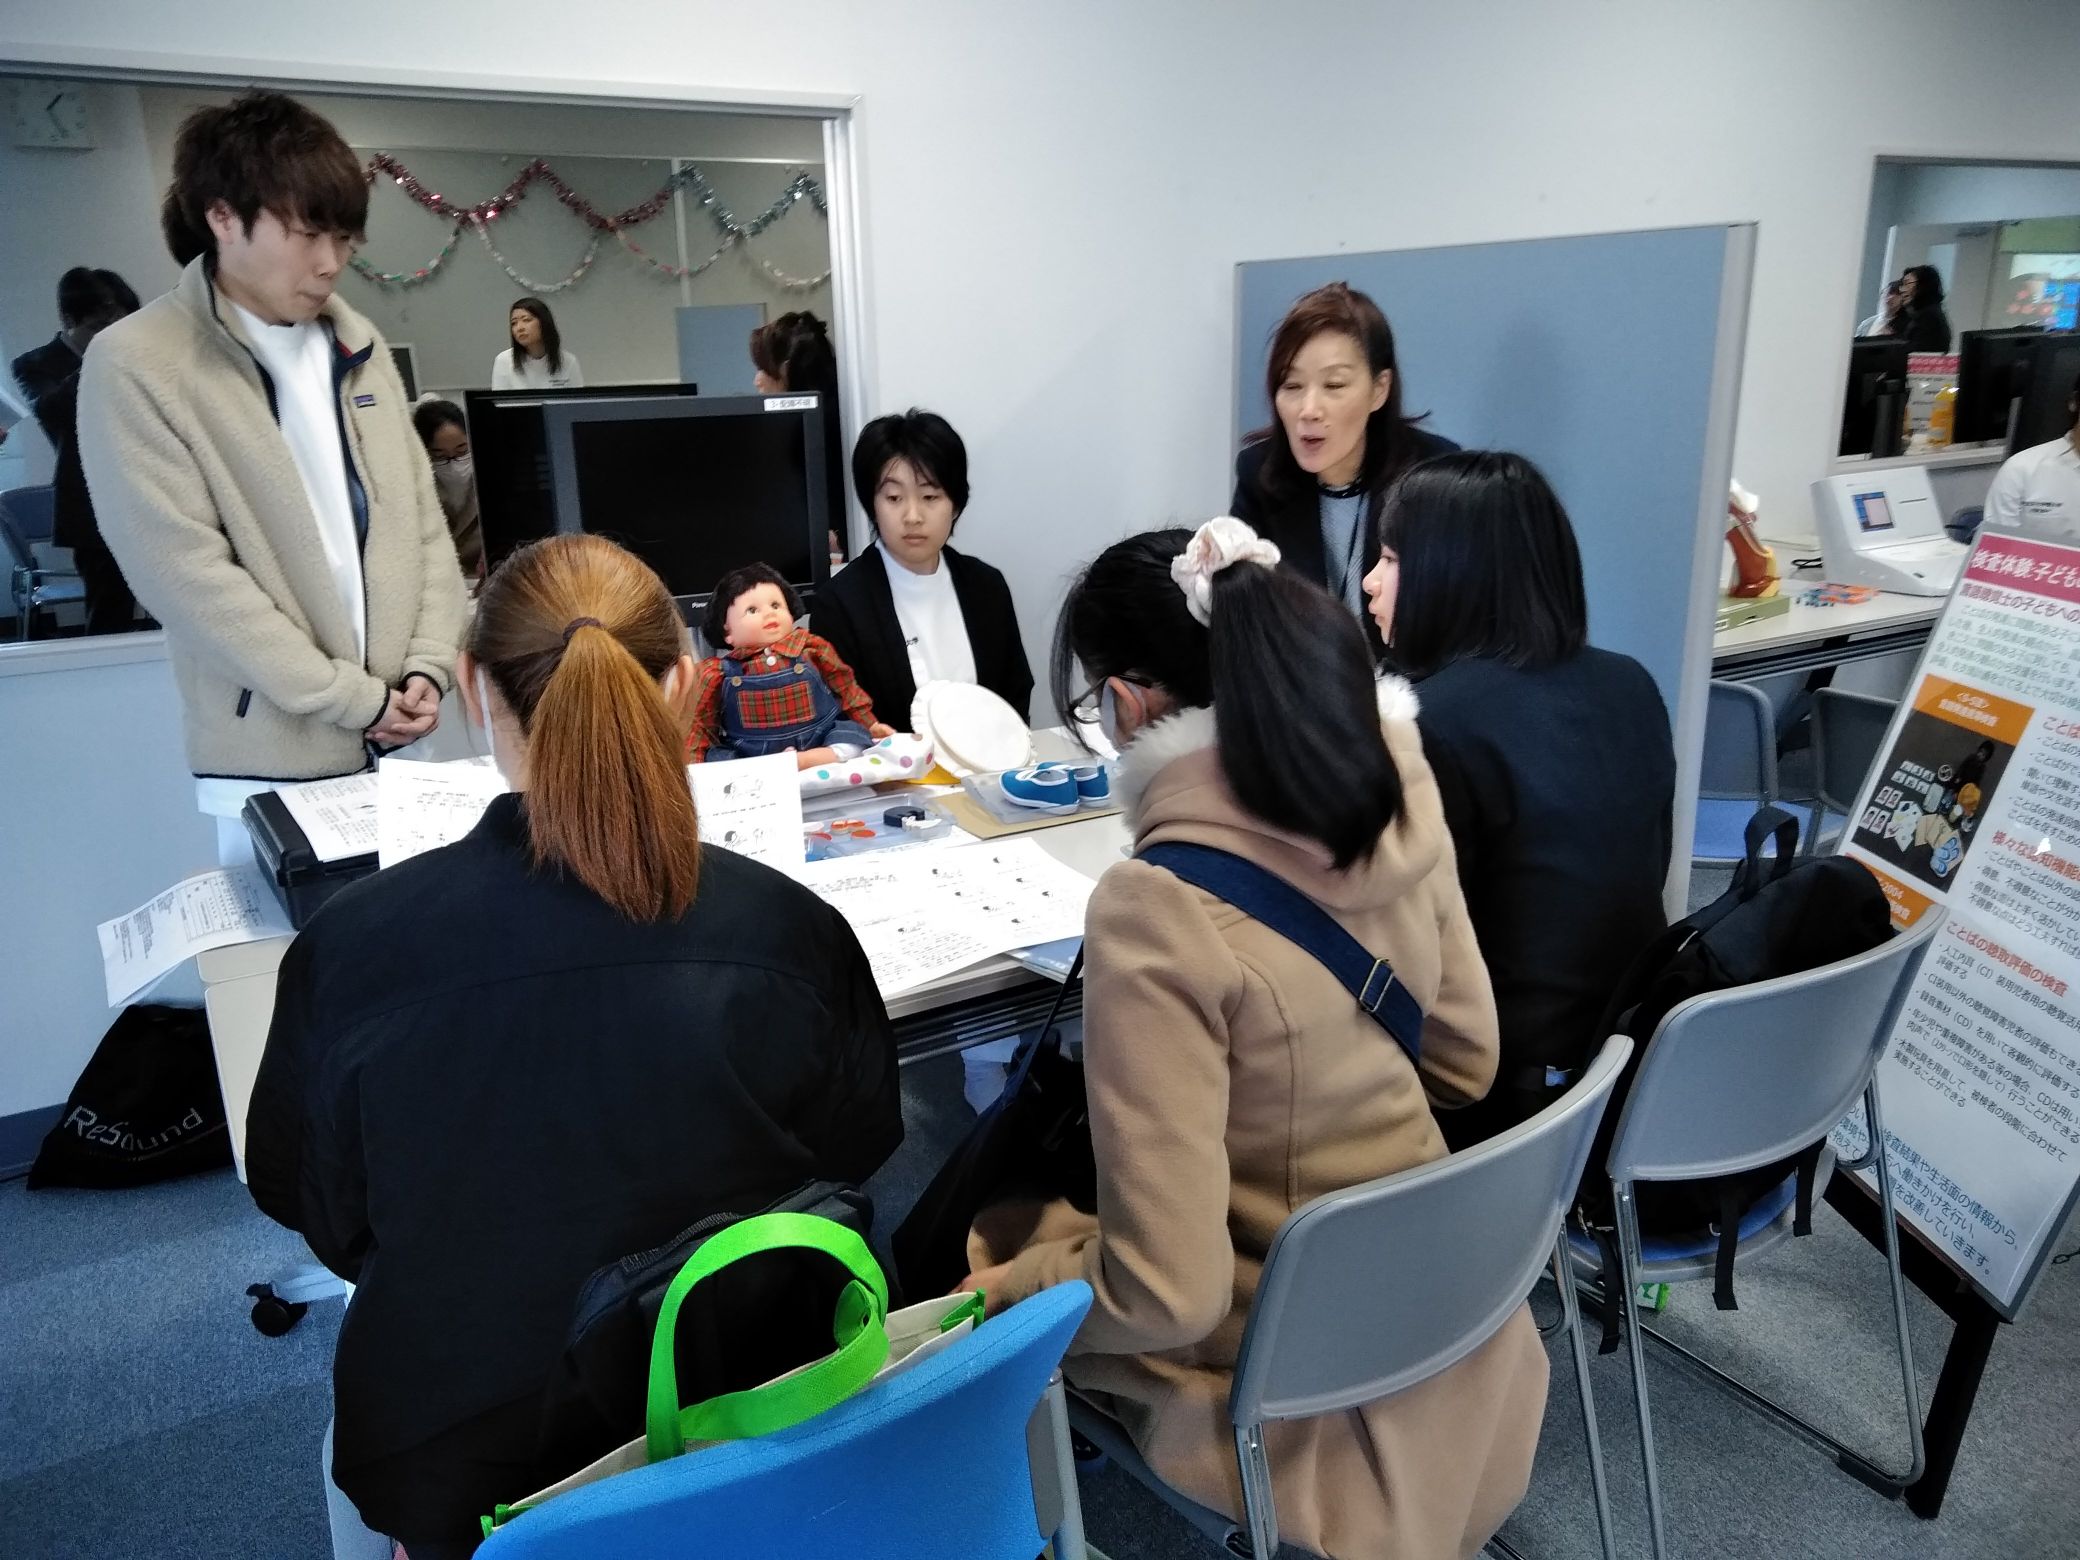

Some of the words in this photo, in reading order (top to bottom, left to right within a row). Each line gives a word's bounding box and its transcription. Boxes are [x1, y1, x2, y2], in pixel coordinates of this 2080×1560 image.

[1992, 830, 2080, 882] 様々な認知機能
[64, 1105, 203, 1150] ReSound
